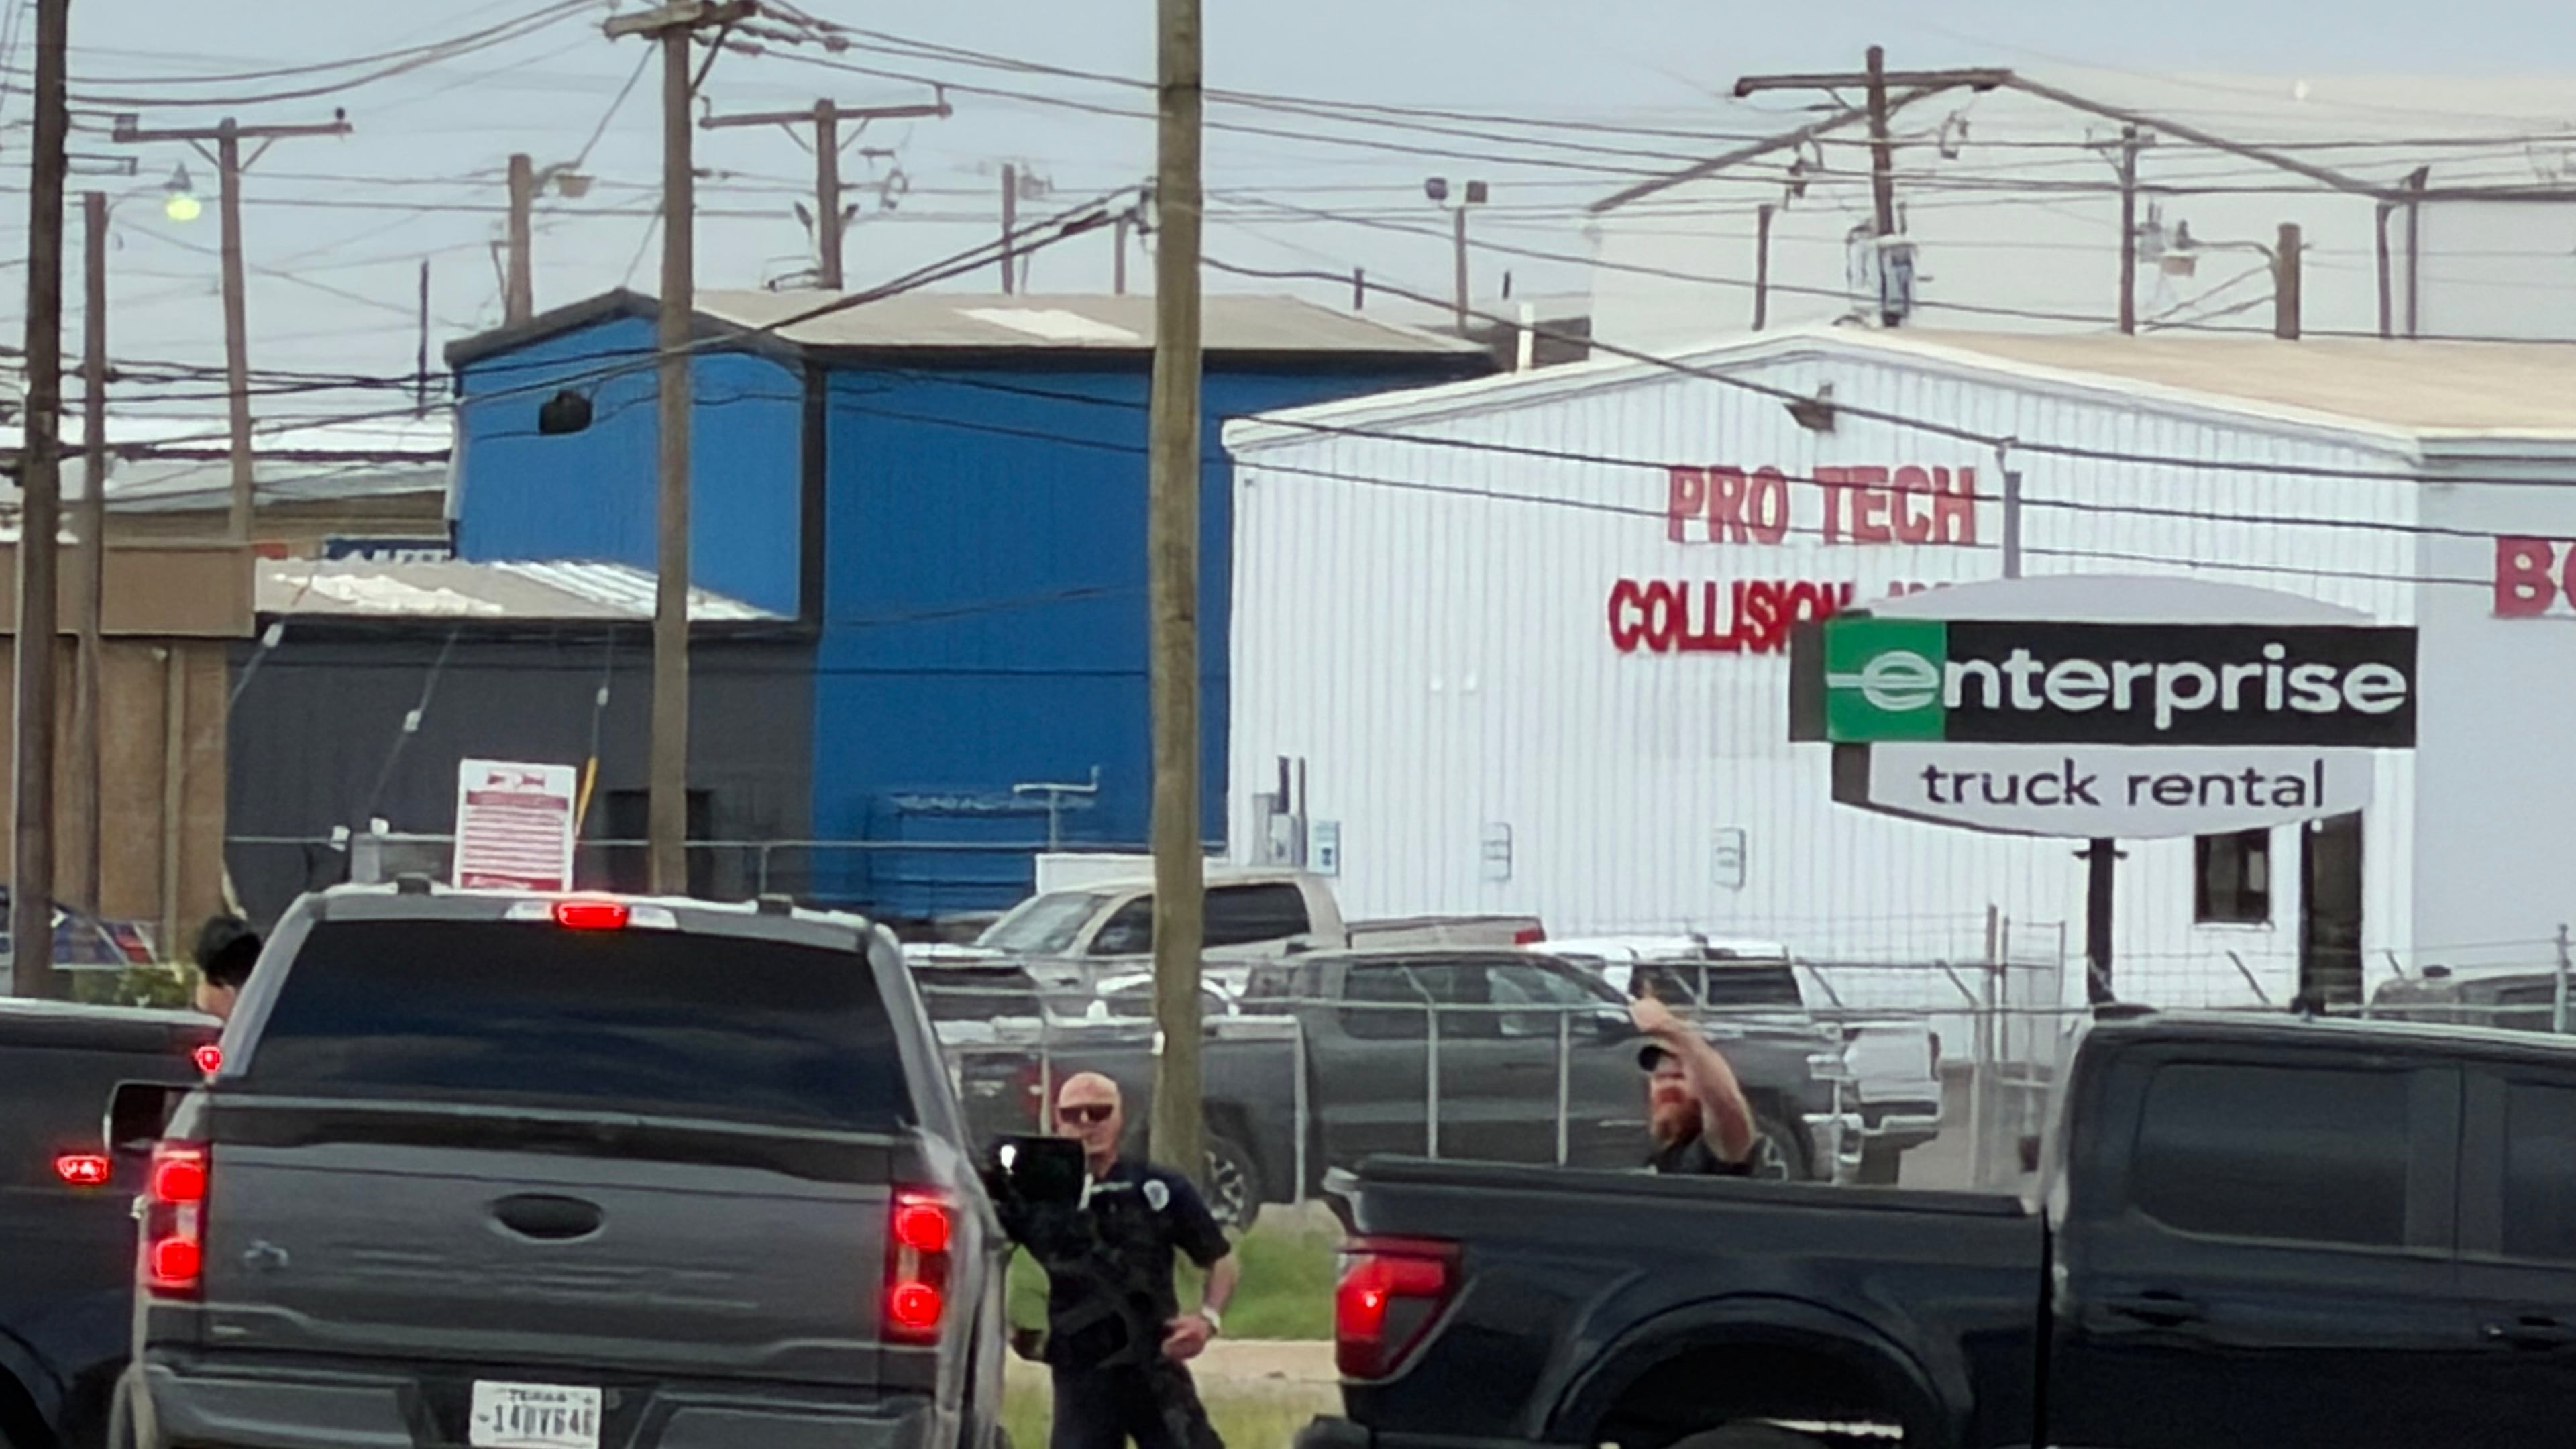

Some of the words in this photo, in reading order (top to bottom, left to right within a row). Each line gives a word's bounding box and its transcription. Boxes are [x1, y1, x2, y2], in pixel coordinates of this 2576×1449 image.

[1669, 466, 1787, 543] PRO
[1815, 466, 1975, 543] TECH
[2495, 535, 2576, 619] B
[1861, 643, 2408, 730] enterprise
[1919, 758, 2100, 806] truck
[2127, 758, 2325, 807] rental
